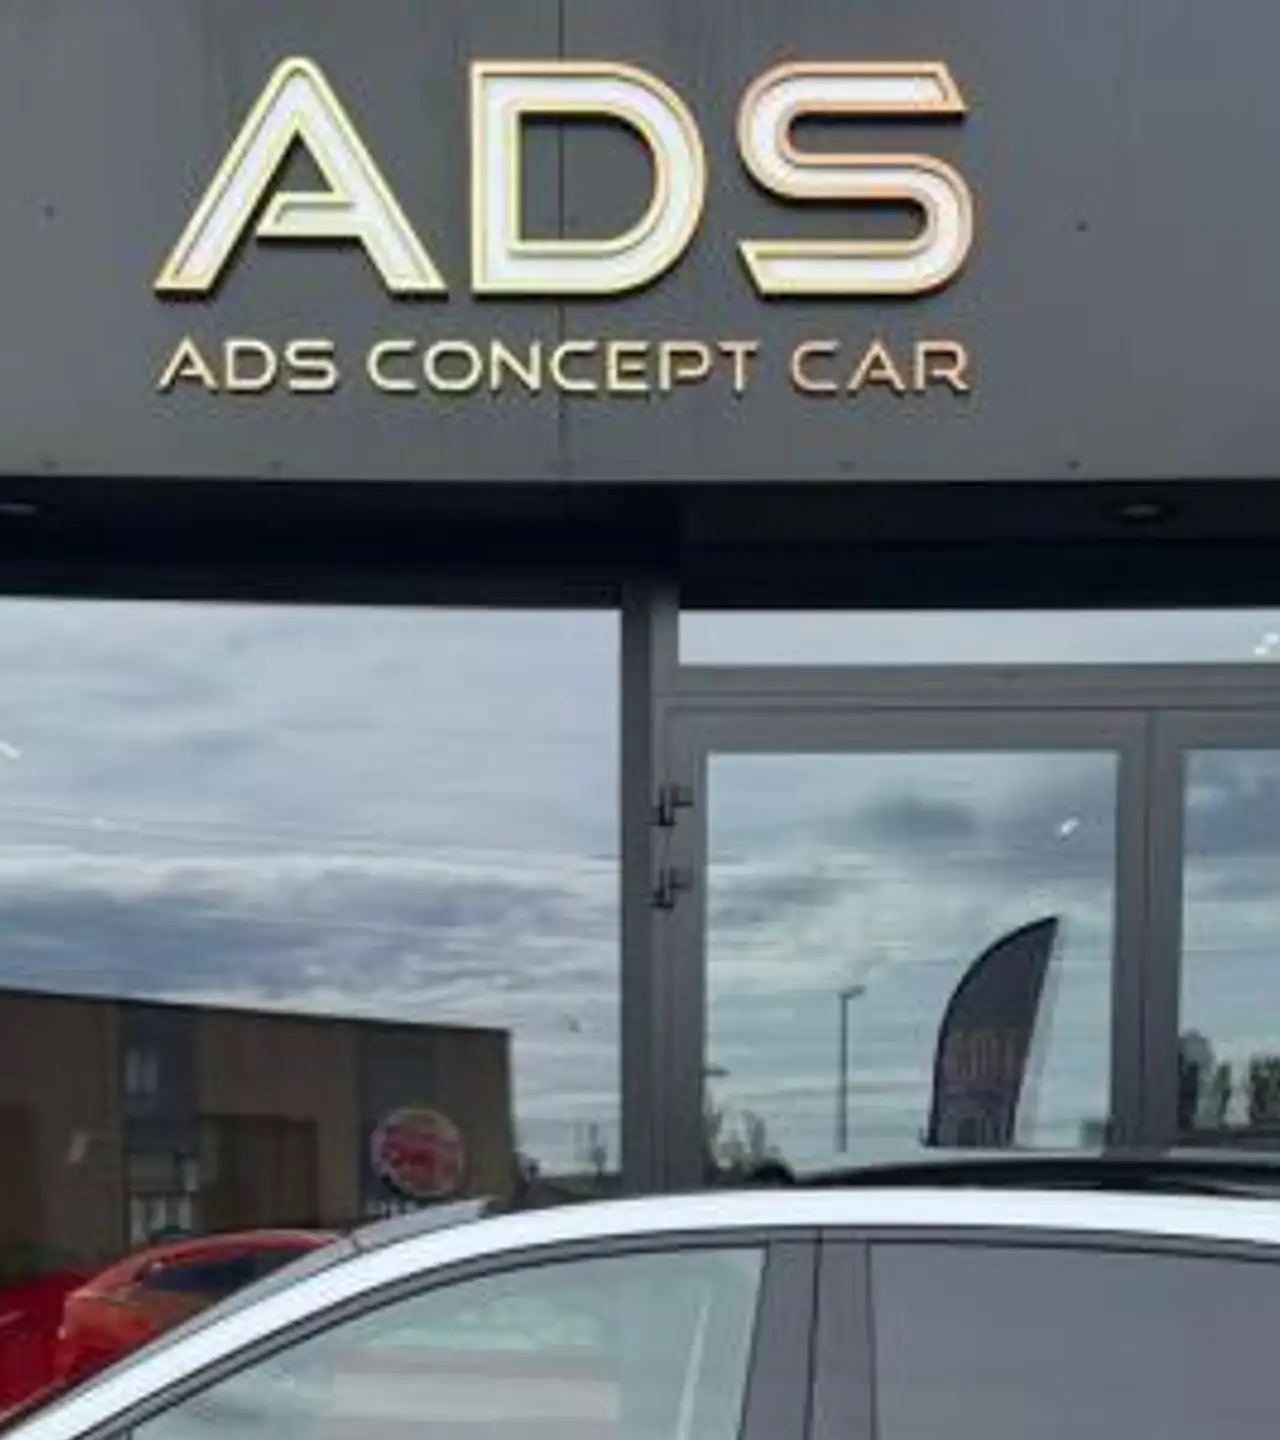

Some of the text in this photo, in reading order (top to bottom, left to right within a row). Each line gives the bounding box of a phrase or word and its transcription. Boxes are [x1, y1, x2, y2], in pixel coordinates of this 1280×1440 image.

[154, 56, 974, 297] ADS
[157, 338, 971, 394] ADS CONCEPT CAR
